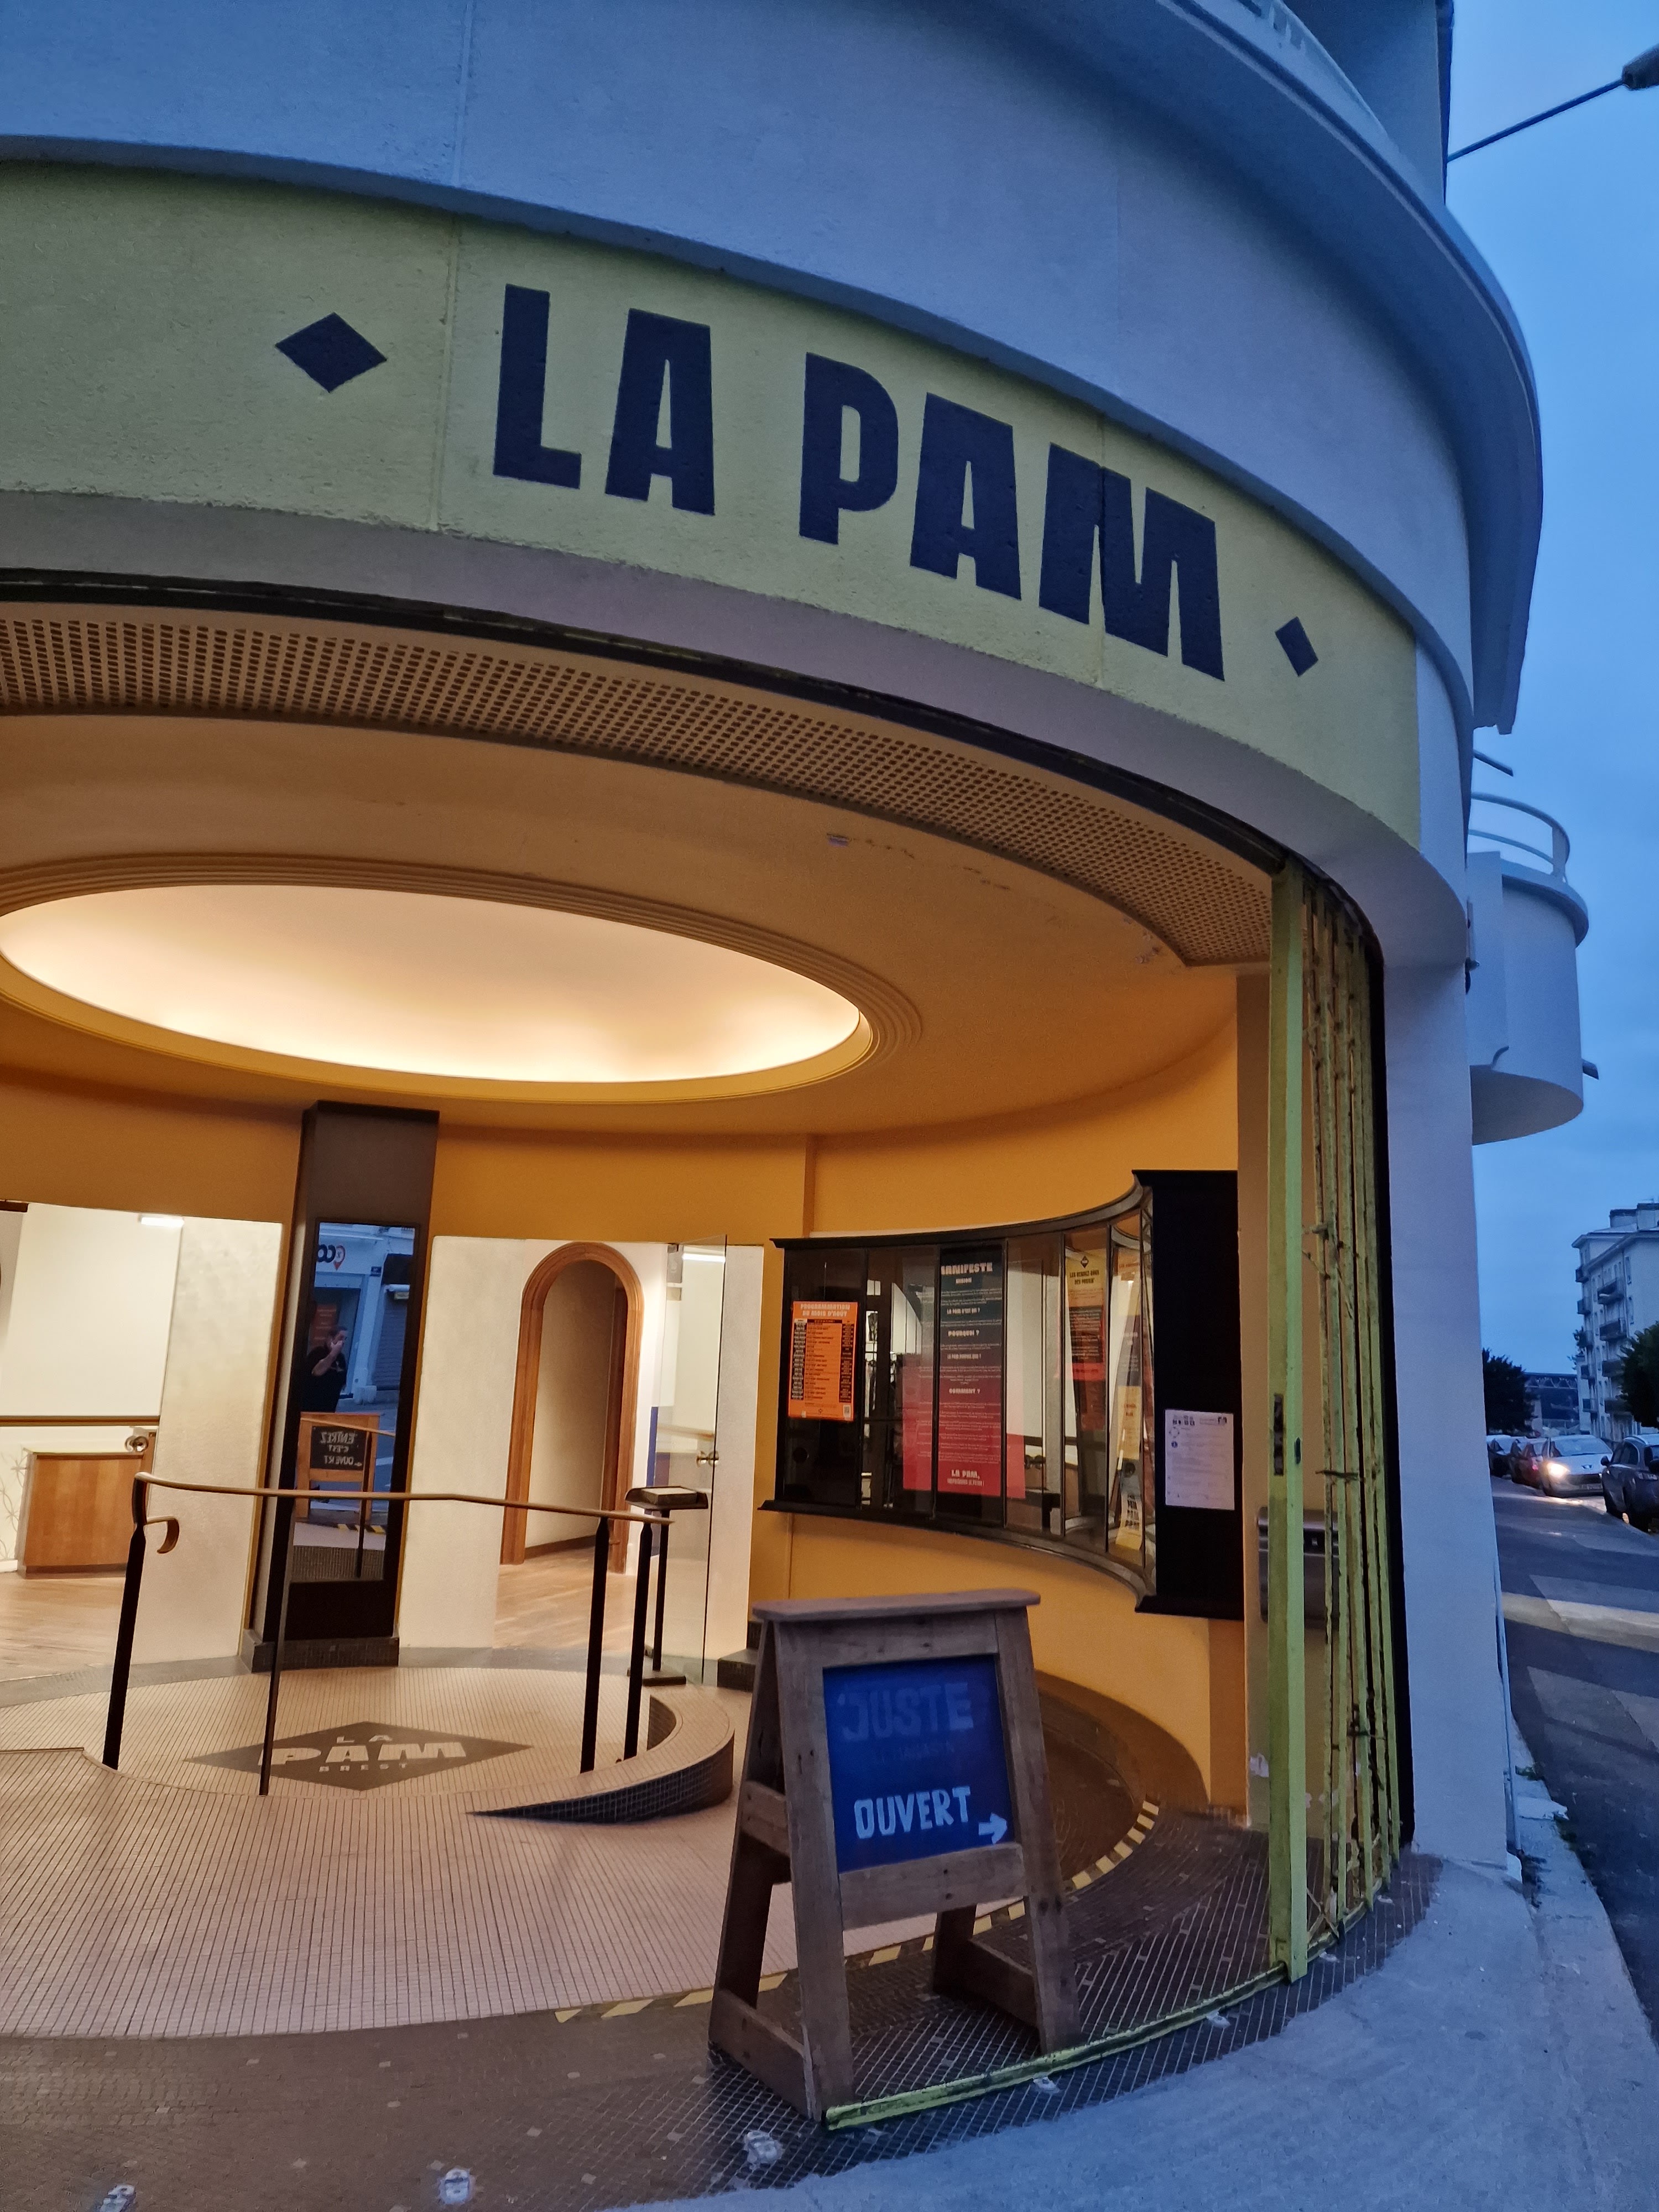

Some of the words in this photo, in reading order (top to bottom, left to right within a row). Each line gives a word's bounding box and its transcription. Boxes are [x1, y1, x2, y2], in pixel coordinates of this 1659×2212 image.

[493, 283, 715, 515] LA
[799, 352, 1225, 681] PAM
[839, 1682, 974, 1741] JUSTE
[258, 1743, 467, 1766] PAM
[336, 1734, 393, 1744] LA
[854, 1786, 971, 1839] OUVERT
